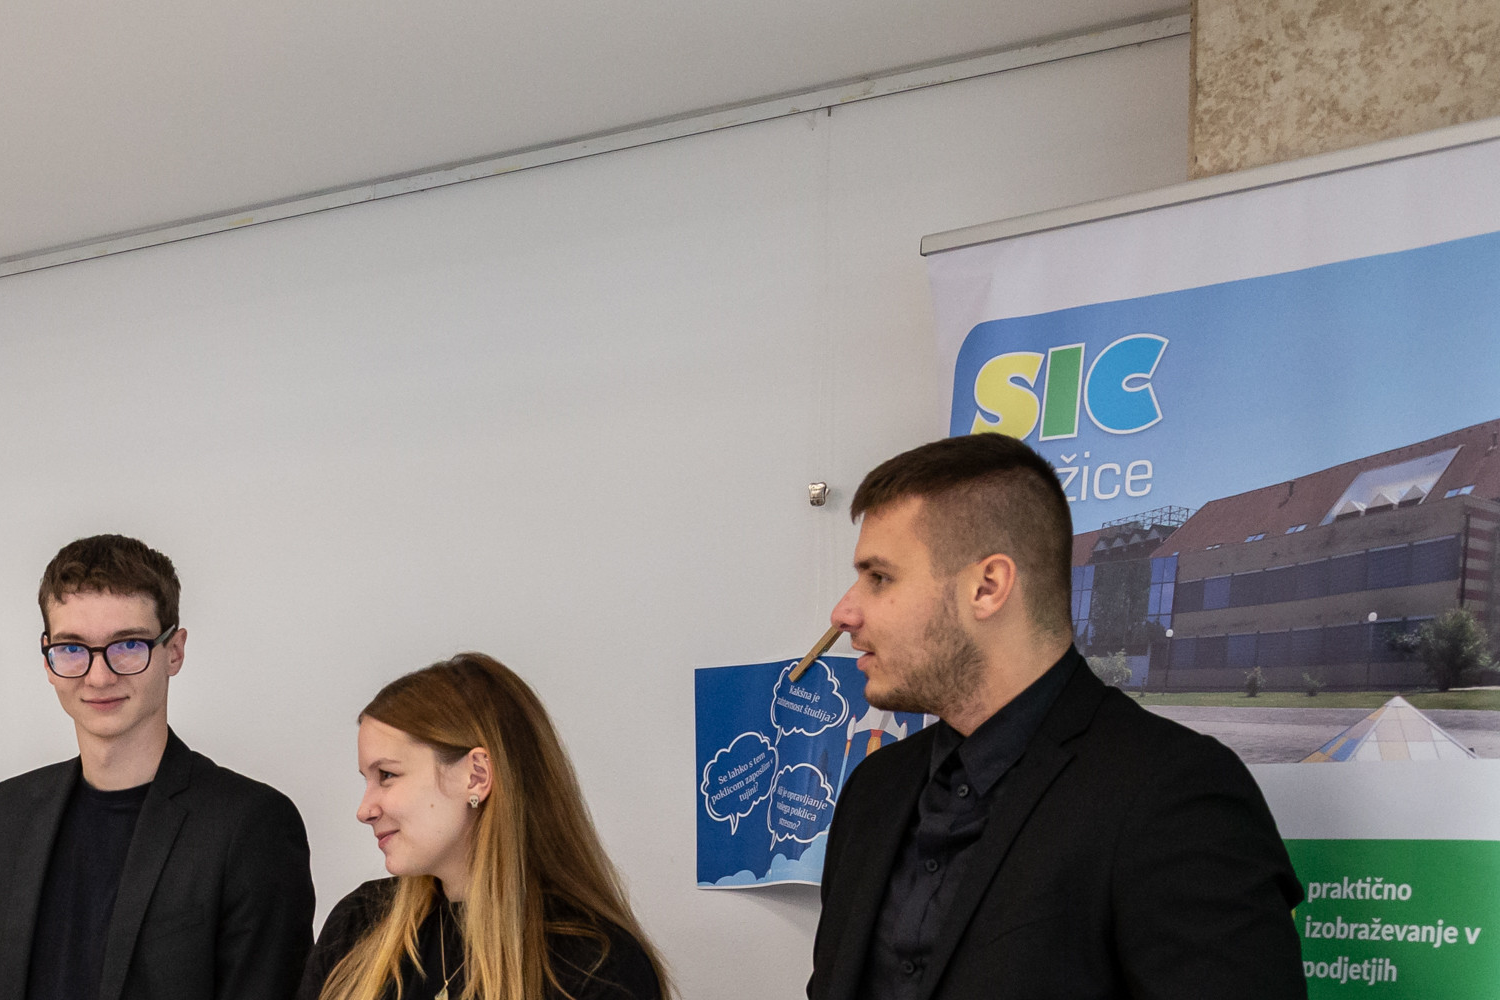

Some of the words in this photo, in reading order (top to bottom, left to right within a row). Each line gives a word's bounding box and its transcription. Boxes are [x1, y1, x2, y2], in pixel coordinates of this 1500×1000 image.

[969, 333, 1170, 442] SIC
[810, 692, 820, 704] je
[803, 704, 837, 723] študija?
[718, 776, 728, 784] Se
[728, 762, 749, 780] lahko
[754, 752, 766, 765] tem
[711, 781, 744, 805] poklicom
[744, 763, 771, 785] zaposlim
[739, 782, 759, 802] tujini?
[788, 790, 828, 810] opravljanje
[791, 806, 817, 822] poklica
[1307, 876, 1412, 904] praktično
[1304, 915, 1459, 948] izobraževanje
[1464, 926, 1482, 945] v
[1302, 956, 1398, 986] podjetjih
